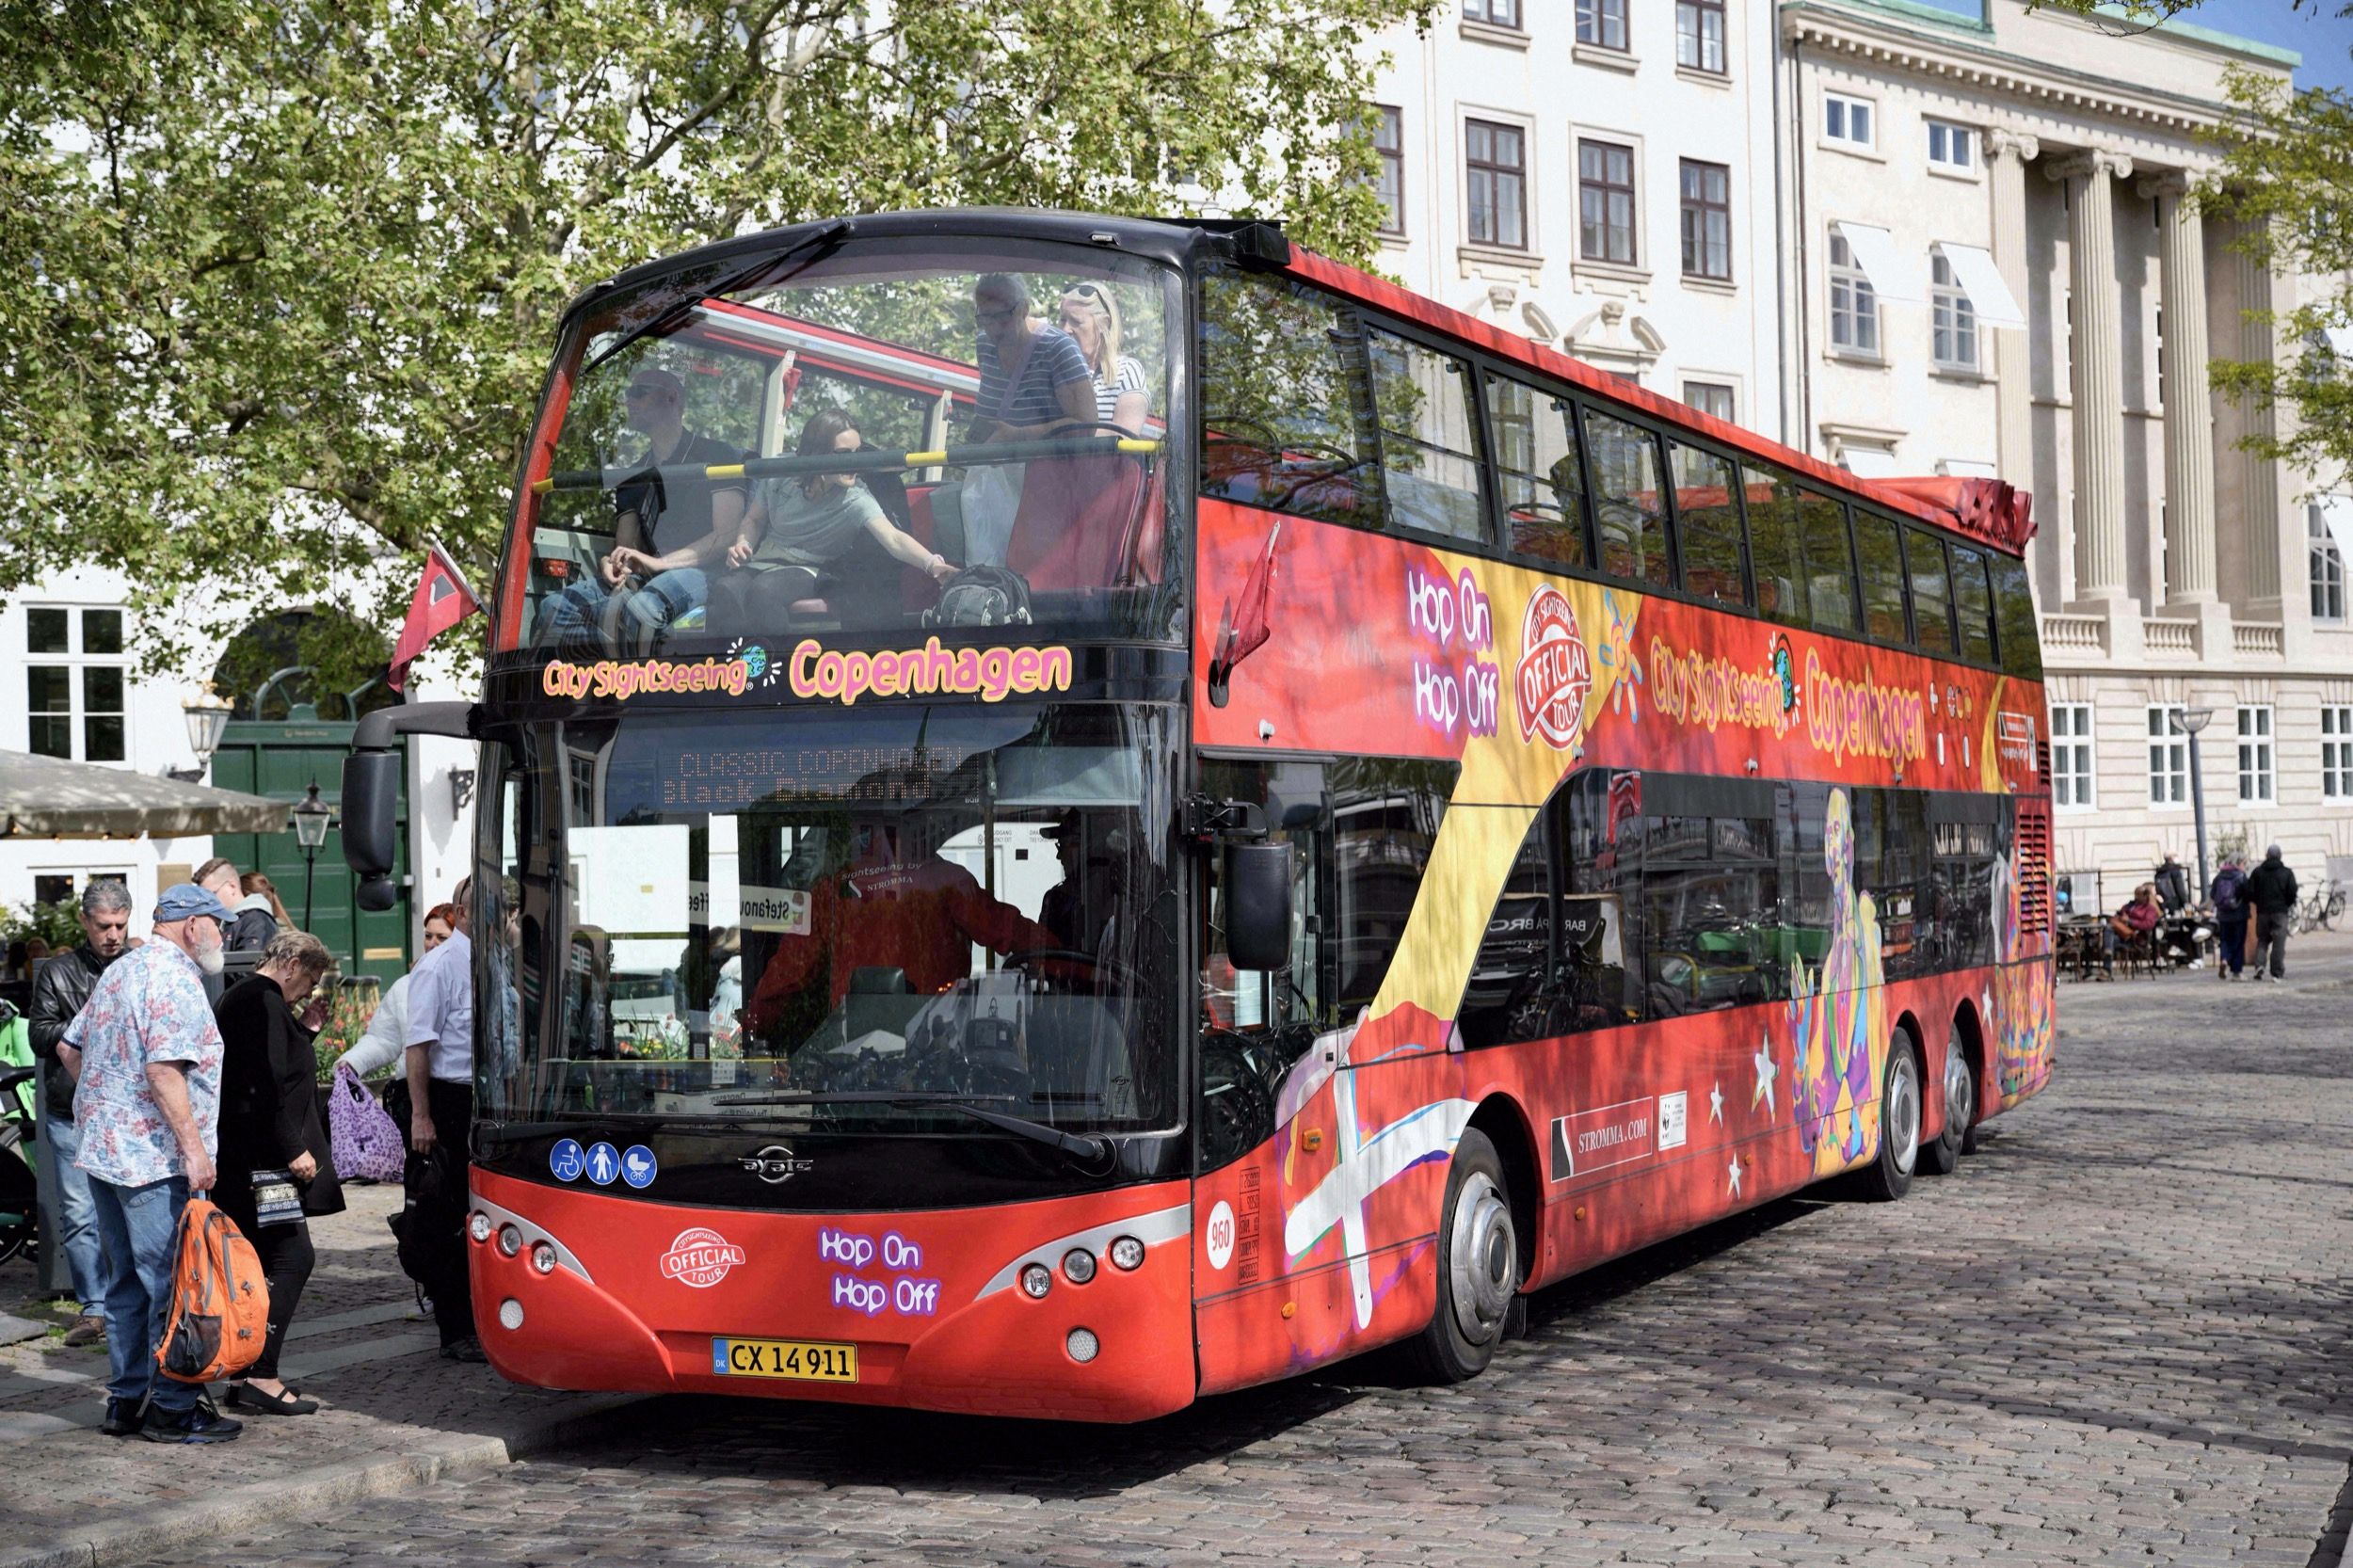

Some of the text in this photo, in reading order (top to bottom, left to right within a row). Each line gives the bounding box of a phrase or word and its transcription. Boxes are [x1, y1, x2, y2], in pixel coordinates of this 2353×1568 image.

[1408, 570, 1491, 646] Hop On
[790, 635, 1072, 705] Copenhagen
[1524, 644, 1590, 713] OFFICIAL
[1415, 661, 1497, 733] Hop Off
[1553, 690, 1579, 729] TOUR
[1805, 646, 1926, 774] Copenhagen
[680, 751, 785, 777] CLASSIC
[664, 778, 754, 804] Black
[867, 875, 914, 892] STROMMA
[1578, 1118, 1647, 1153] STROMMA.COM
[822, 1231, 919, 1266] Hop On
[1211, 1219, 1230, 1251] 960
[669, 1248, 741, 1272] OFFICIAL
[692, 1267, 724, 1284] TOUR
[835, 1277, 937, 1313] Hop Off
[715, 1344, 850, 1376] DK CX 14 911
